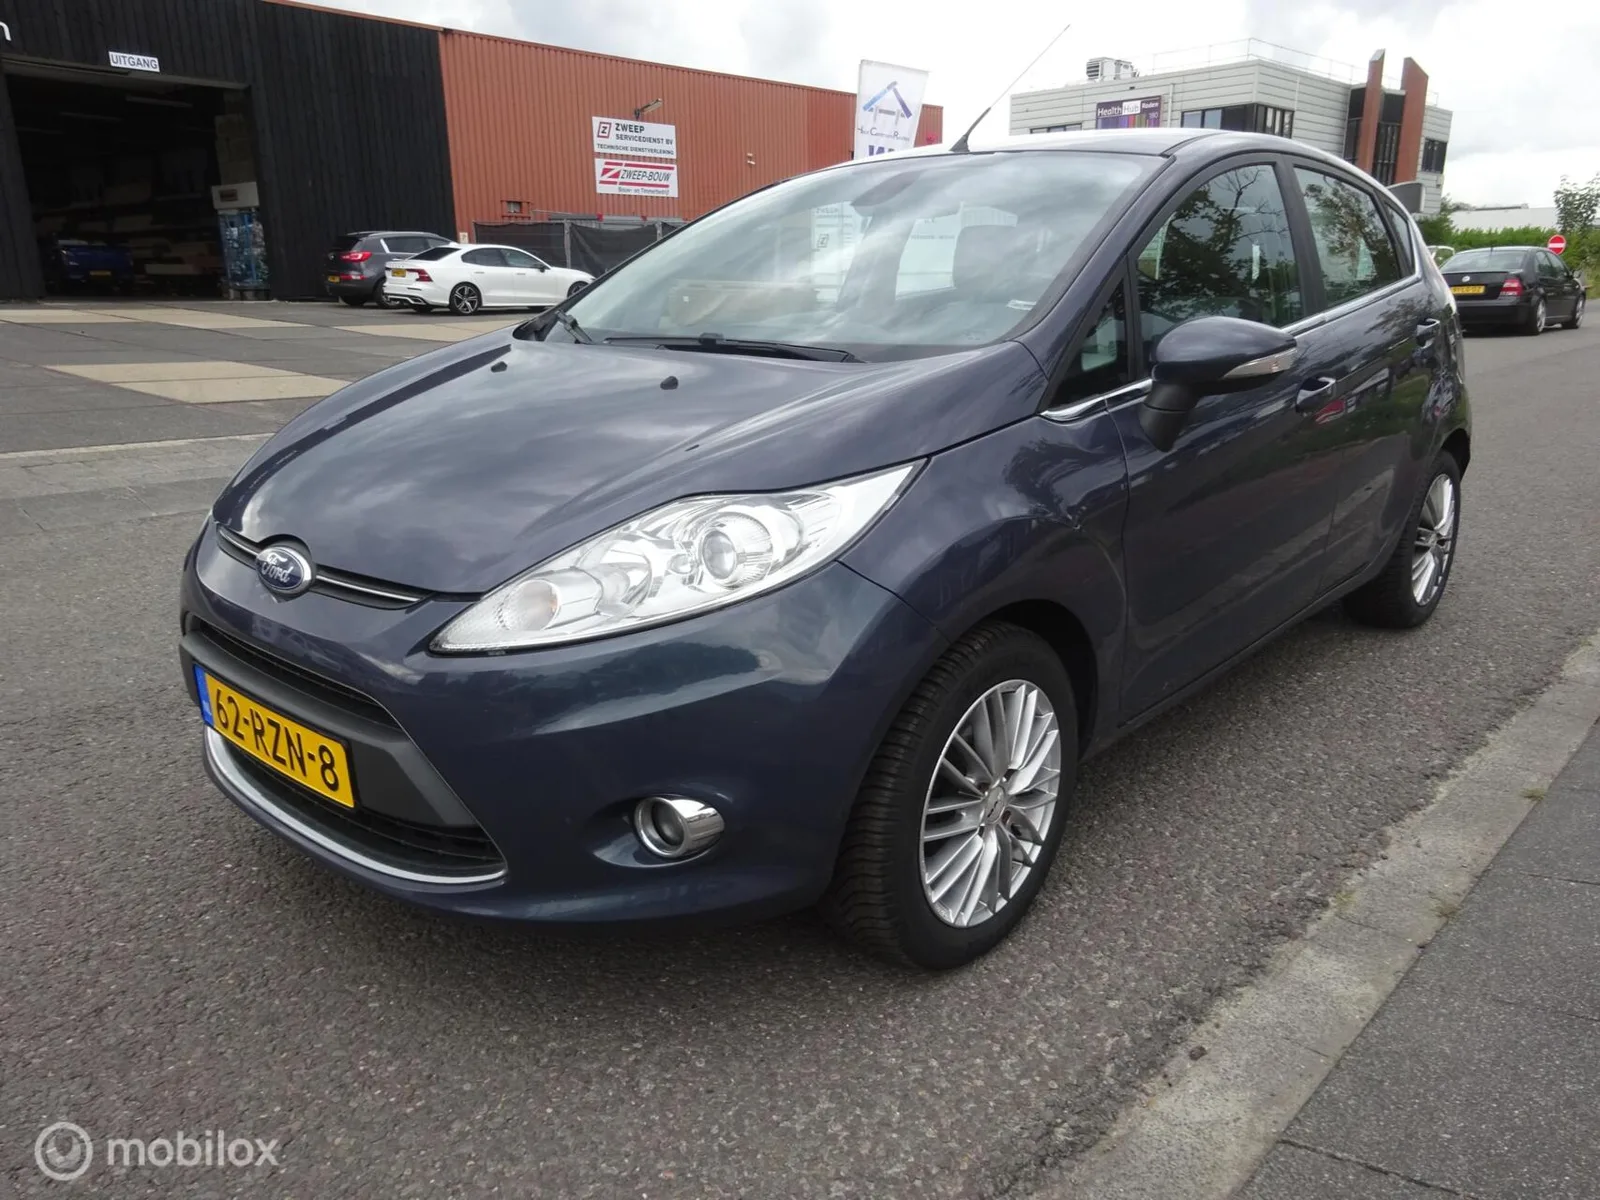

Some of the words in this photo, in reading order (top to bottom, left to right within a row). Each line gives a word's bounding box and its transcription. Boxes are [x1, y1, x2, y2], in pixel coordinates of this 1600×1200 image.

[110, 53, 158, 70] UITGANG
[1097, 106, 1122, 116] Health
[1123, 103, 1139, 114] Hub
[615, 123, 645, 133] ZWEEP
[615, 134, 664, 145] SERVICEDIENST
[597, 143, 629, 152] TECHNISCHE
[630, 146, 674, 155] DIENSTVERLENING
[620, 169, 672, 182] ZWEEP-BOUW
[261, 552, 294, 583] Ford
[216, 688, 340, 792] 62-RZN-8
